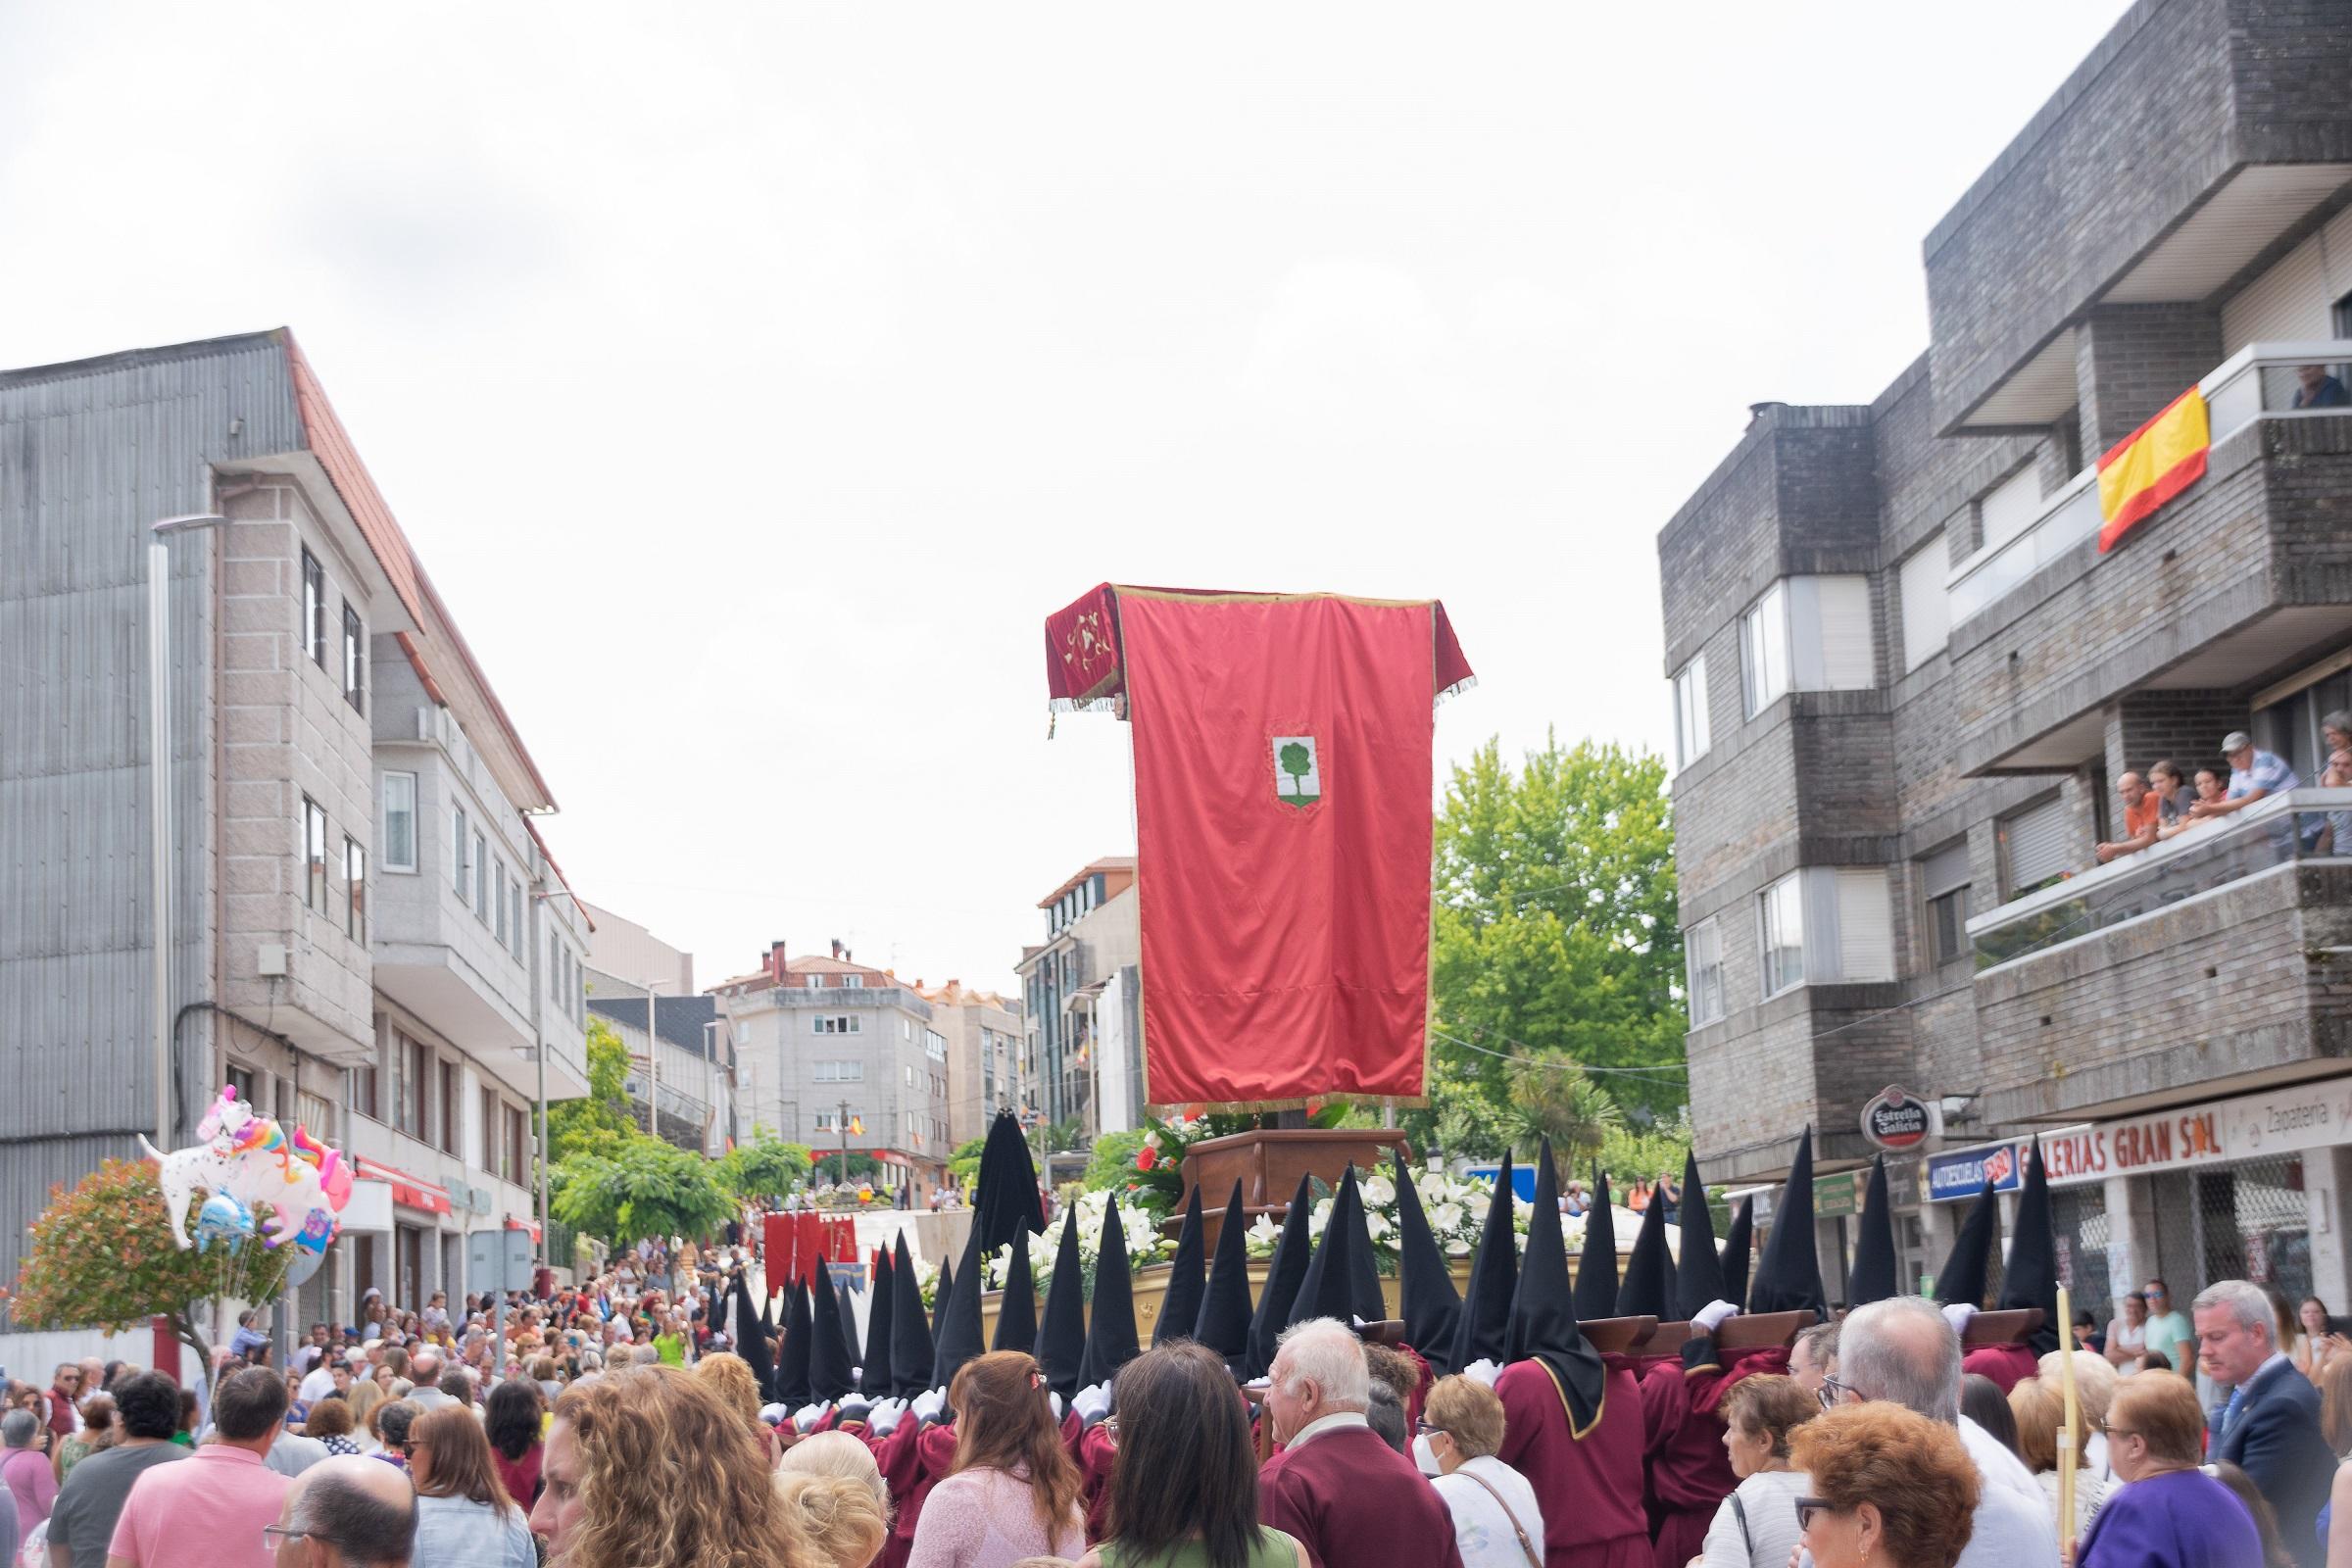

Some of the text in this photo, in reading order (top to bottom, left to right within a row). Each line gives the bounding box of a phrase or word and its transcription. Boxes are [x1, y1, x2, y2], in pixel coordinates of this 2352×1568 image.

[1875, 1107, 1921, 1122] Estrella
[1878, 1121, 1921, 1135] Galicia
[2019, 1131, 2106, 1179] GLERIAS
[2114, 1120, 2172, 1168] GRAN
[1932, 1159, 1984, 1189] AUTOESCUELAS
